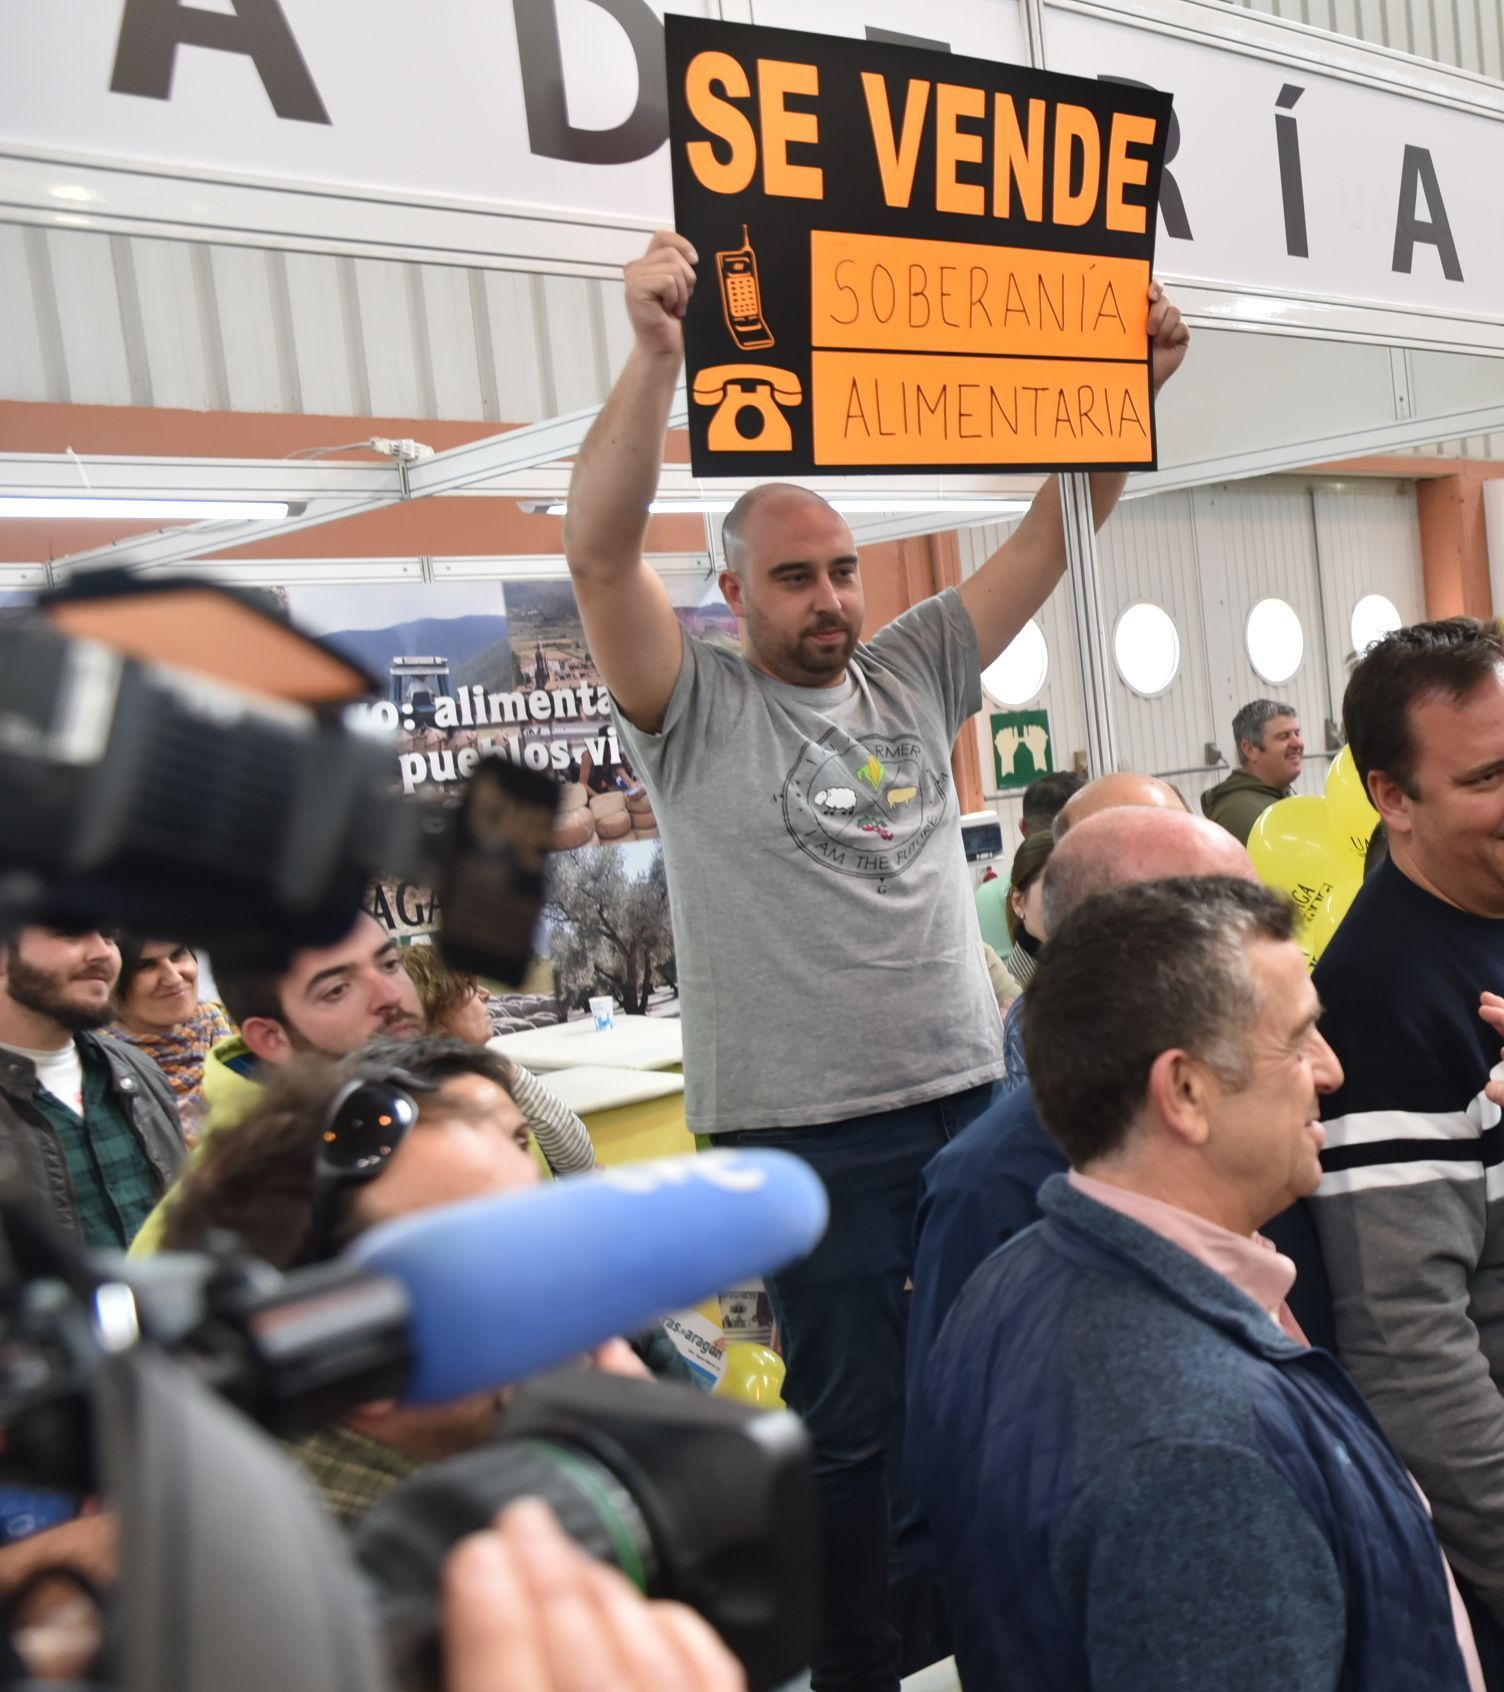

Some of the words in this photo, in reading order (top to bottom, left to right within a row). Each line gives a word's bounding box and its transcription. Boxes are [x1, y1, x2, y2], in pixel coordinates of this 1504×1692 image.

[685, 50, 824, 200] SE
[860, 71, 1157, 234] VENDE
[829, 258, 1126, 334] SOBERANÍA
[843, 376, 1148, 440] ALIMENTARIA
[814, 842, 846, 865] AM
[856, 855, 890, 870] THE
